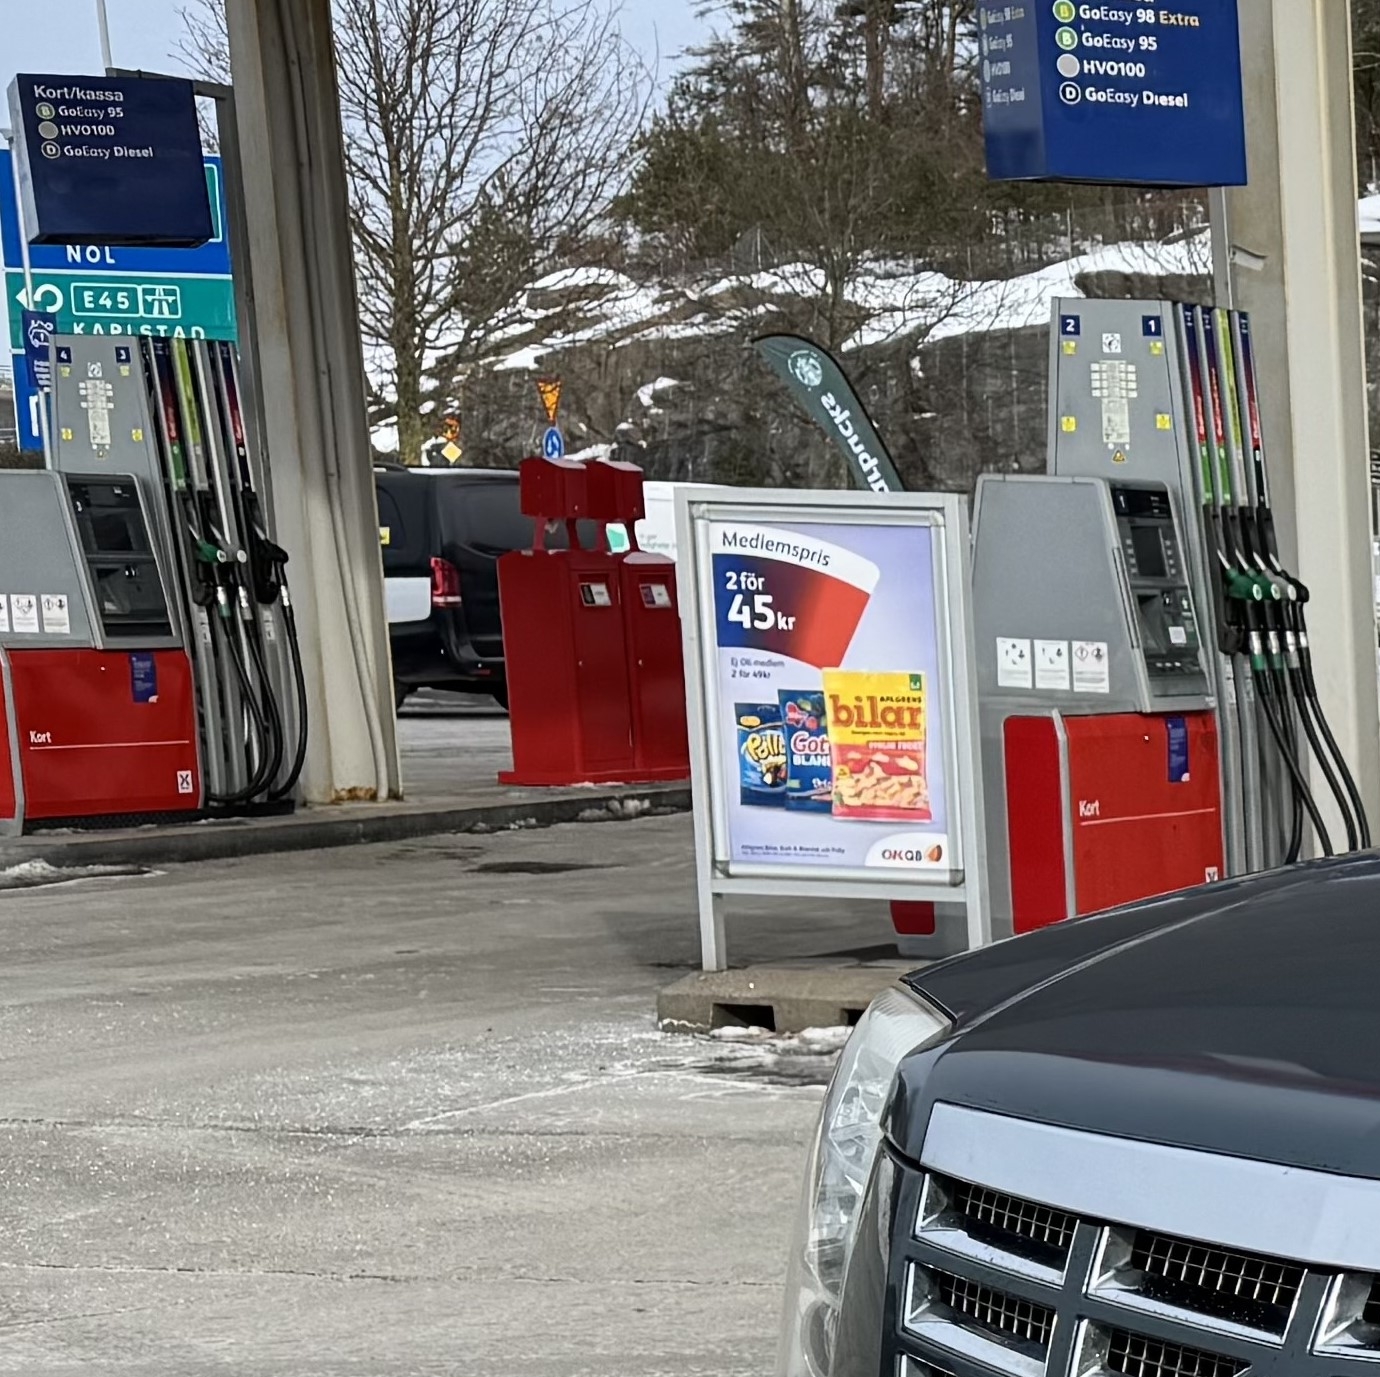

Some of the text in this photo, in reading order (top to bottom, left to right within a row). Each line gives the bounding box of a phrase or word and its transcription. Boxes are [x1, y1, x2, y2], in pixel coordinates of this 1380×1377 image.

[1079, 5, 1134, 25] GoEasy
[1136, 9, 1155, 23] 98
[1159, 11, 1200, 27] Extra
[1082, 33, 1135, 53] GoEasy
[1139, 36, 1157, 50] 95
[1084, 60, 1146, 77] HVO100
[33, 85, 124, 101] Kort/kassa
[1085, 87, 1138, 107] GoEasy
[1143, 91, 1189, 108] Diesel
[58, 106, 104, 120] GoEasy
[107, 107, 124, 118] 95
[61, 125, 115, 136] HVO100
[64, 146, 110, 159] GoEasy
[114, 146, 154, 157] Diesel
[66, 245, 116, 264] NOL
[83, 291, 130, 310] E45
[1066, 320, 1075, 332] 2
[1149, 320, 1156, 332] 1
[722, 531, 831, 567] Medlemspris
[725, 571, 765, 590] 2 för
[829, 694, 922, 730] bilar
[29, 731, 51, 743] Kort
[792, 732, 829, 755] Got
[1078, 800, 1100, 817] Kort
